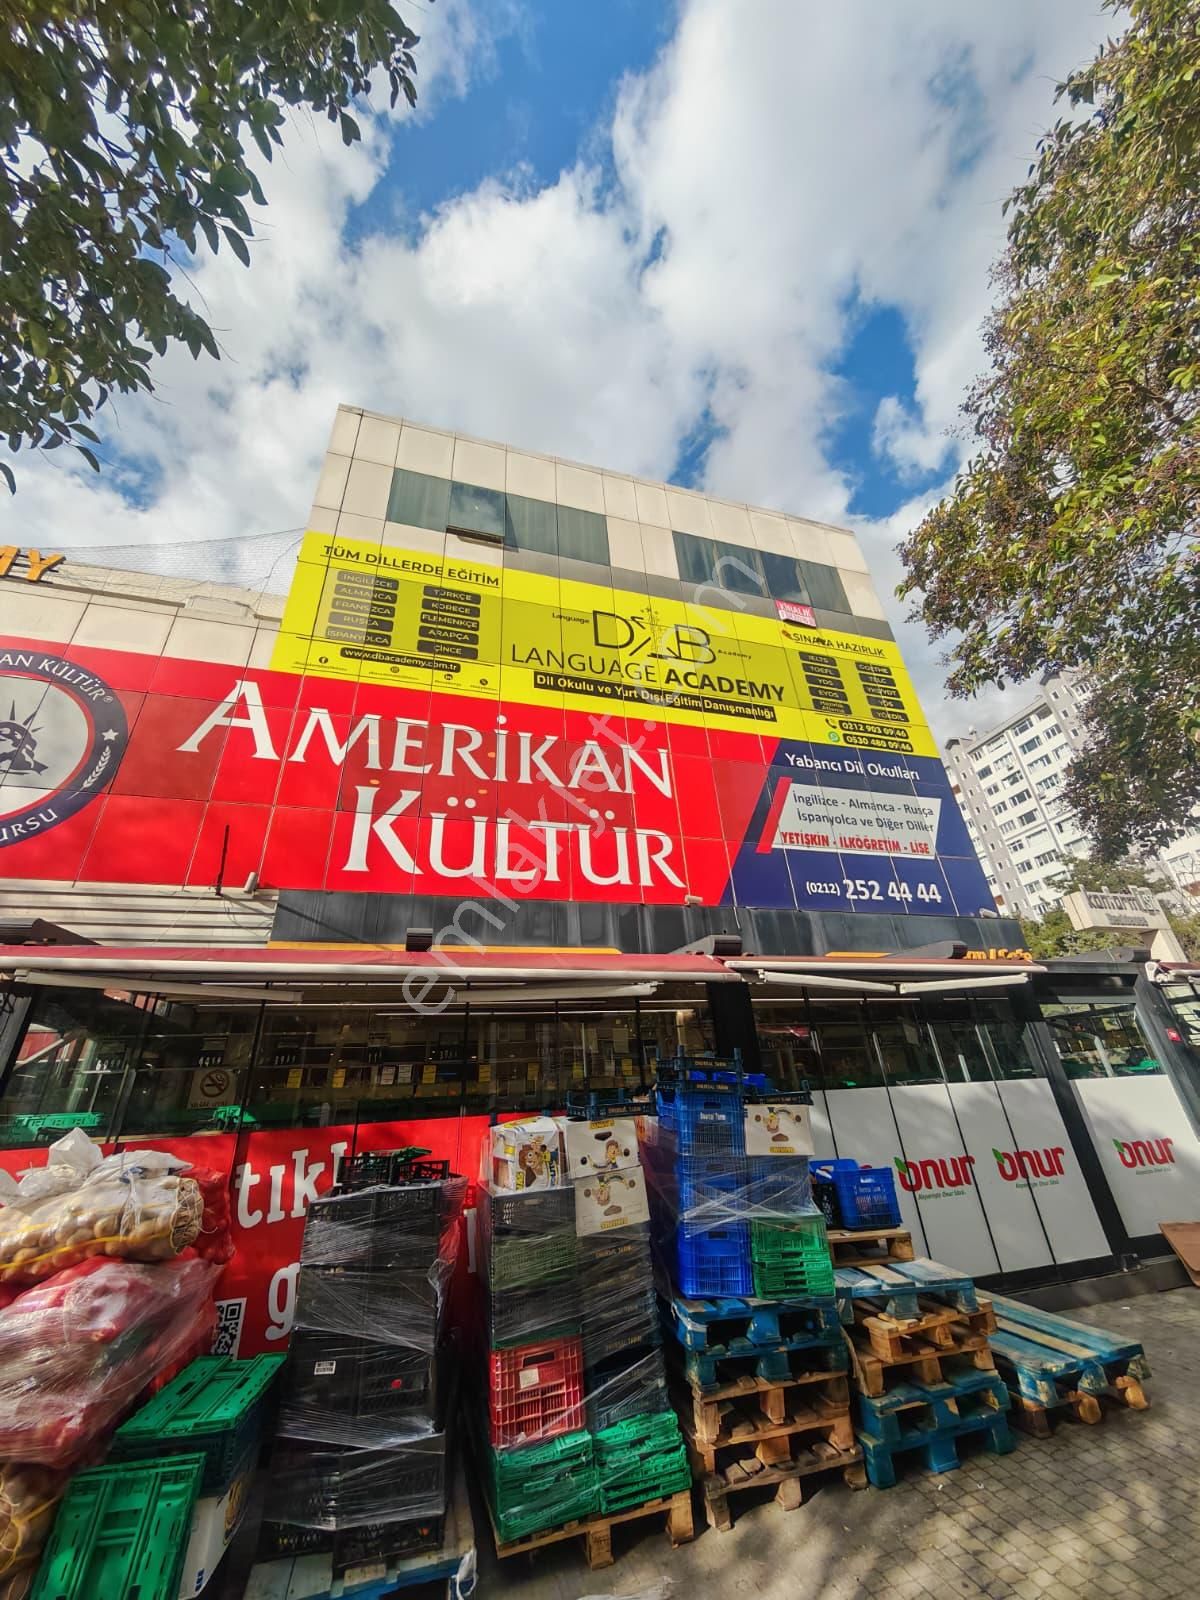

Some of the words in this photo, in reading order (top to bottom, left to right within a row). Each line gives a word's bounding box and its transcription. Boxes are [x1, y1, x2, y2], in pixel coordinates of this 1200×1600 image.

[323, 545, 360, 561] TÜM
[365, 552, 443, 576] DİLLERDE
[447, 568, 499, 587] EĞİTİM
[339, 586, 393, 601] ALMANCA
[431, 602, 471, 614] KORECE
[552, 612, 590, 624] Language
[344, 649, 458, 672] www.dbacademy.com.tr
[512, 644, 657, 683] LANGUAGE
[665, 668, 785, 702] ACADEMY
[536, 674, 554, 687] Dil
[559, 677, 594, 693] Okulu
[597, 684, 612, 694] ve
[615, 686, 638, 700] Yurt
[665, 693, 702, 709] Eğitim
[704, 699, 774, 720] Danışmanlığı
[176, 679, 673, 799] AMERİKAN
[842, 722, 865, 732] 0212
[846, 735, 869, 745] 0530
[785, 752, 841, 773] Yabancı
[844, 758, 864, 775] Dil
[867, 762, 920, 781] Okulları
[792, 790, 839, 808] İngilizce
[850, 799, 895, 812] Almanca
[903, 804, 934, 819] Rusça
[797, 808, 858, 829] İspanyolca
[860, 818, 874, 827] ve
[875, 817, 904, 831] Diğer
[906, 820, 934, 832] Diller
[341, 785, 686, 888] KÜLTÜR
[781, 830, 829, 848] YETİŞKİN
[839, 833, 900, 851] İLKÖĞRETİM
[910, 840, 930, 854] LİSE
[806, 881, 840, 897] (0212)
[843, 879, 884, 901] 252
[887, 881, 913, 903] 44
[916, 883, 942, 904] 44
[992, 1147, 1065, 1182] onur
[1112, 1138, 1175, 1168] onur
[894, 1155, 976, 1192] onur
